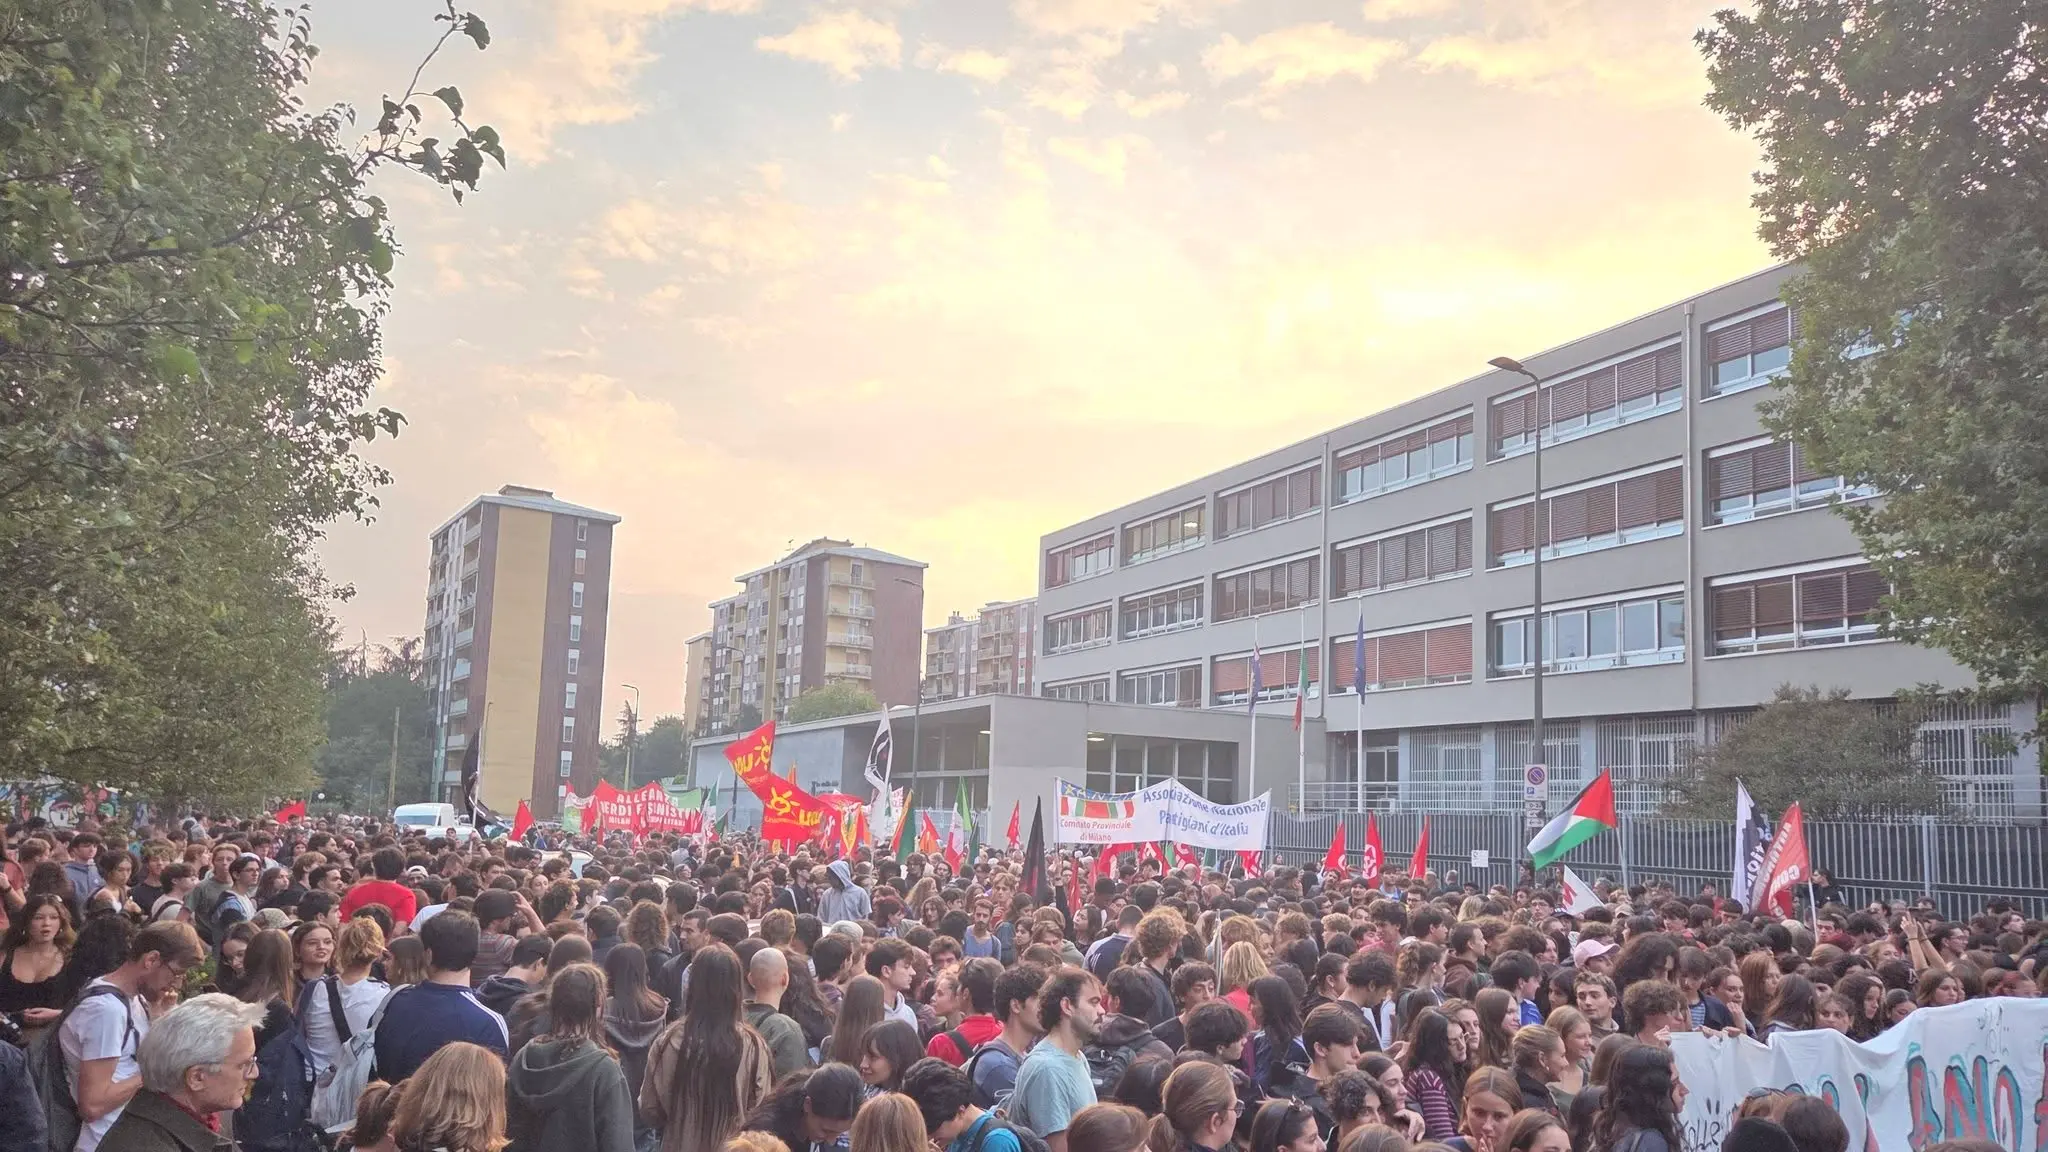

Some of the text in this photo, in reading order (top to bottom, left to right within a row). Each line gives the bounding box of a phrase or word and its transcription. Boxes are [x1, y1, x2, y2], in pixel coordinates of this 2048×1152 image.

[1143, 786, 1209, 812] Associazione
[1212, 800, 1267, 816] Nazionale
[1060, 819, 1132, 829] Comitato Provinciale
[1080, 832, 1112, 842] di Milano
